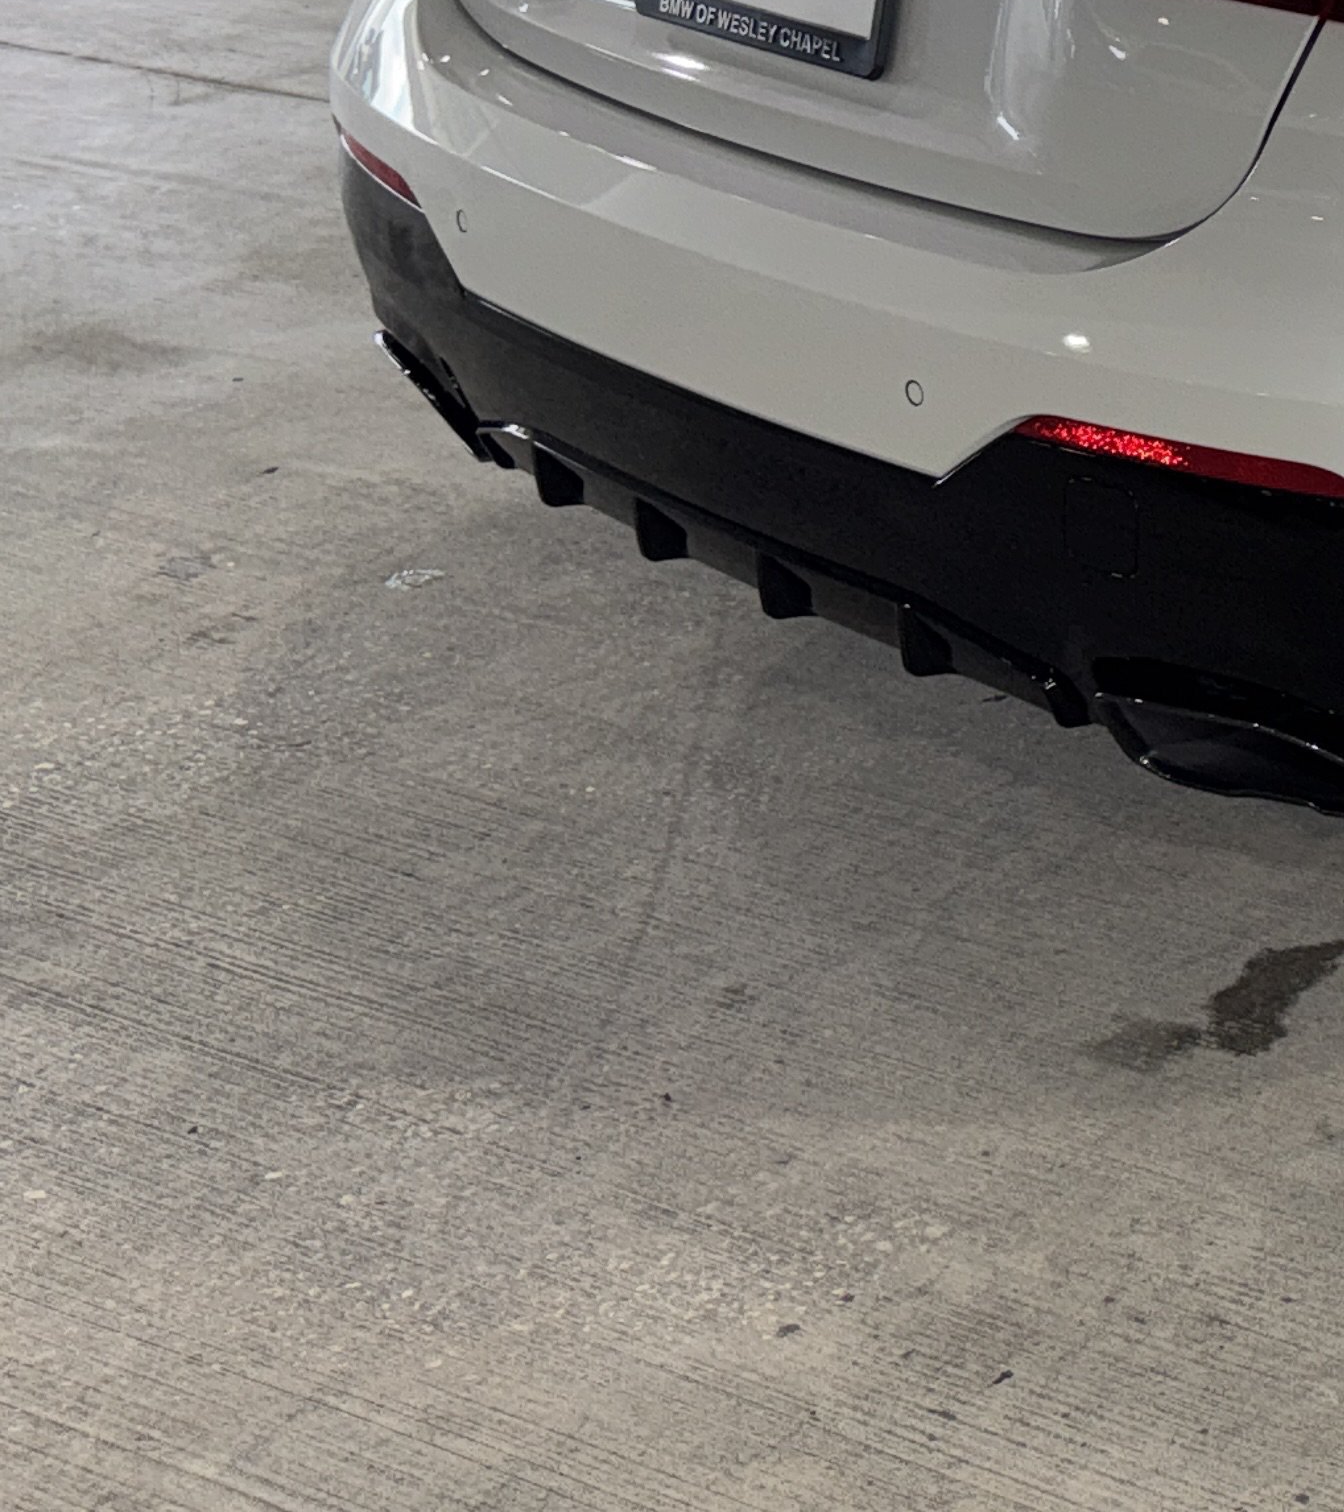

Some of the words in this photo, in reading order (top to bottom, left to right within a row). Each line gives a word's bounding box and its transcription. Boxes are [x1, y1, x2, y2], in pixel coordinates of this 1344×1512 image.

[695, 4, 717, 25] OF
[717, 10, 778, 44] WESLEY
[779, 27, 841, 62] CHAPEL
